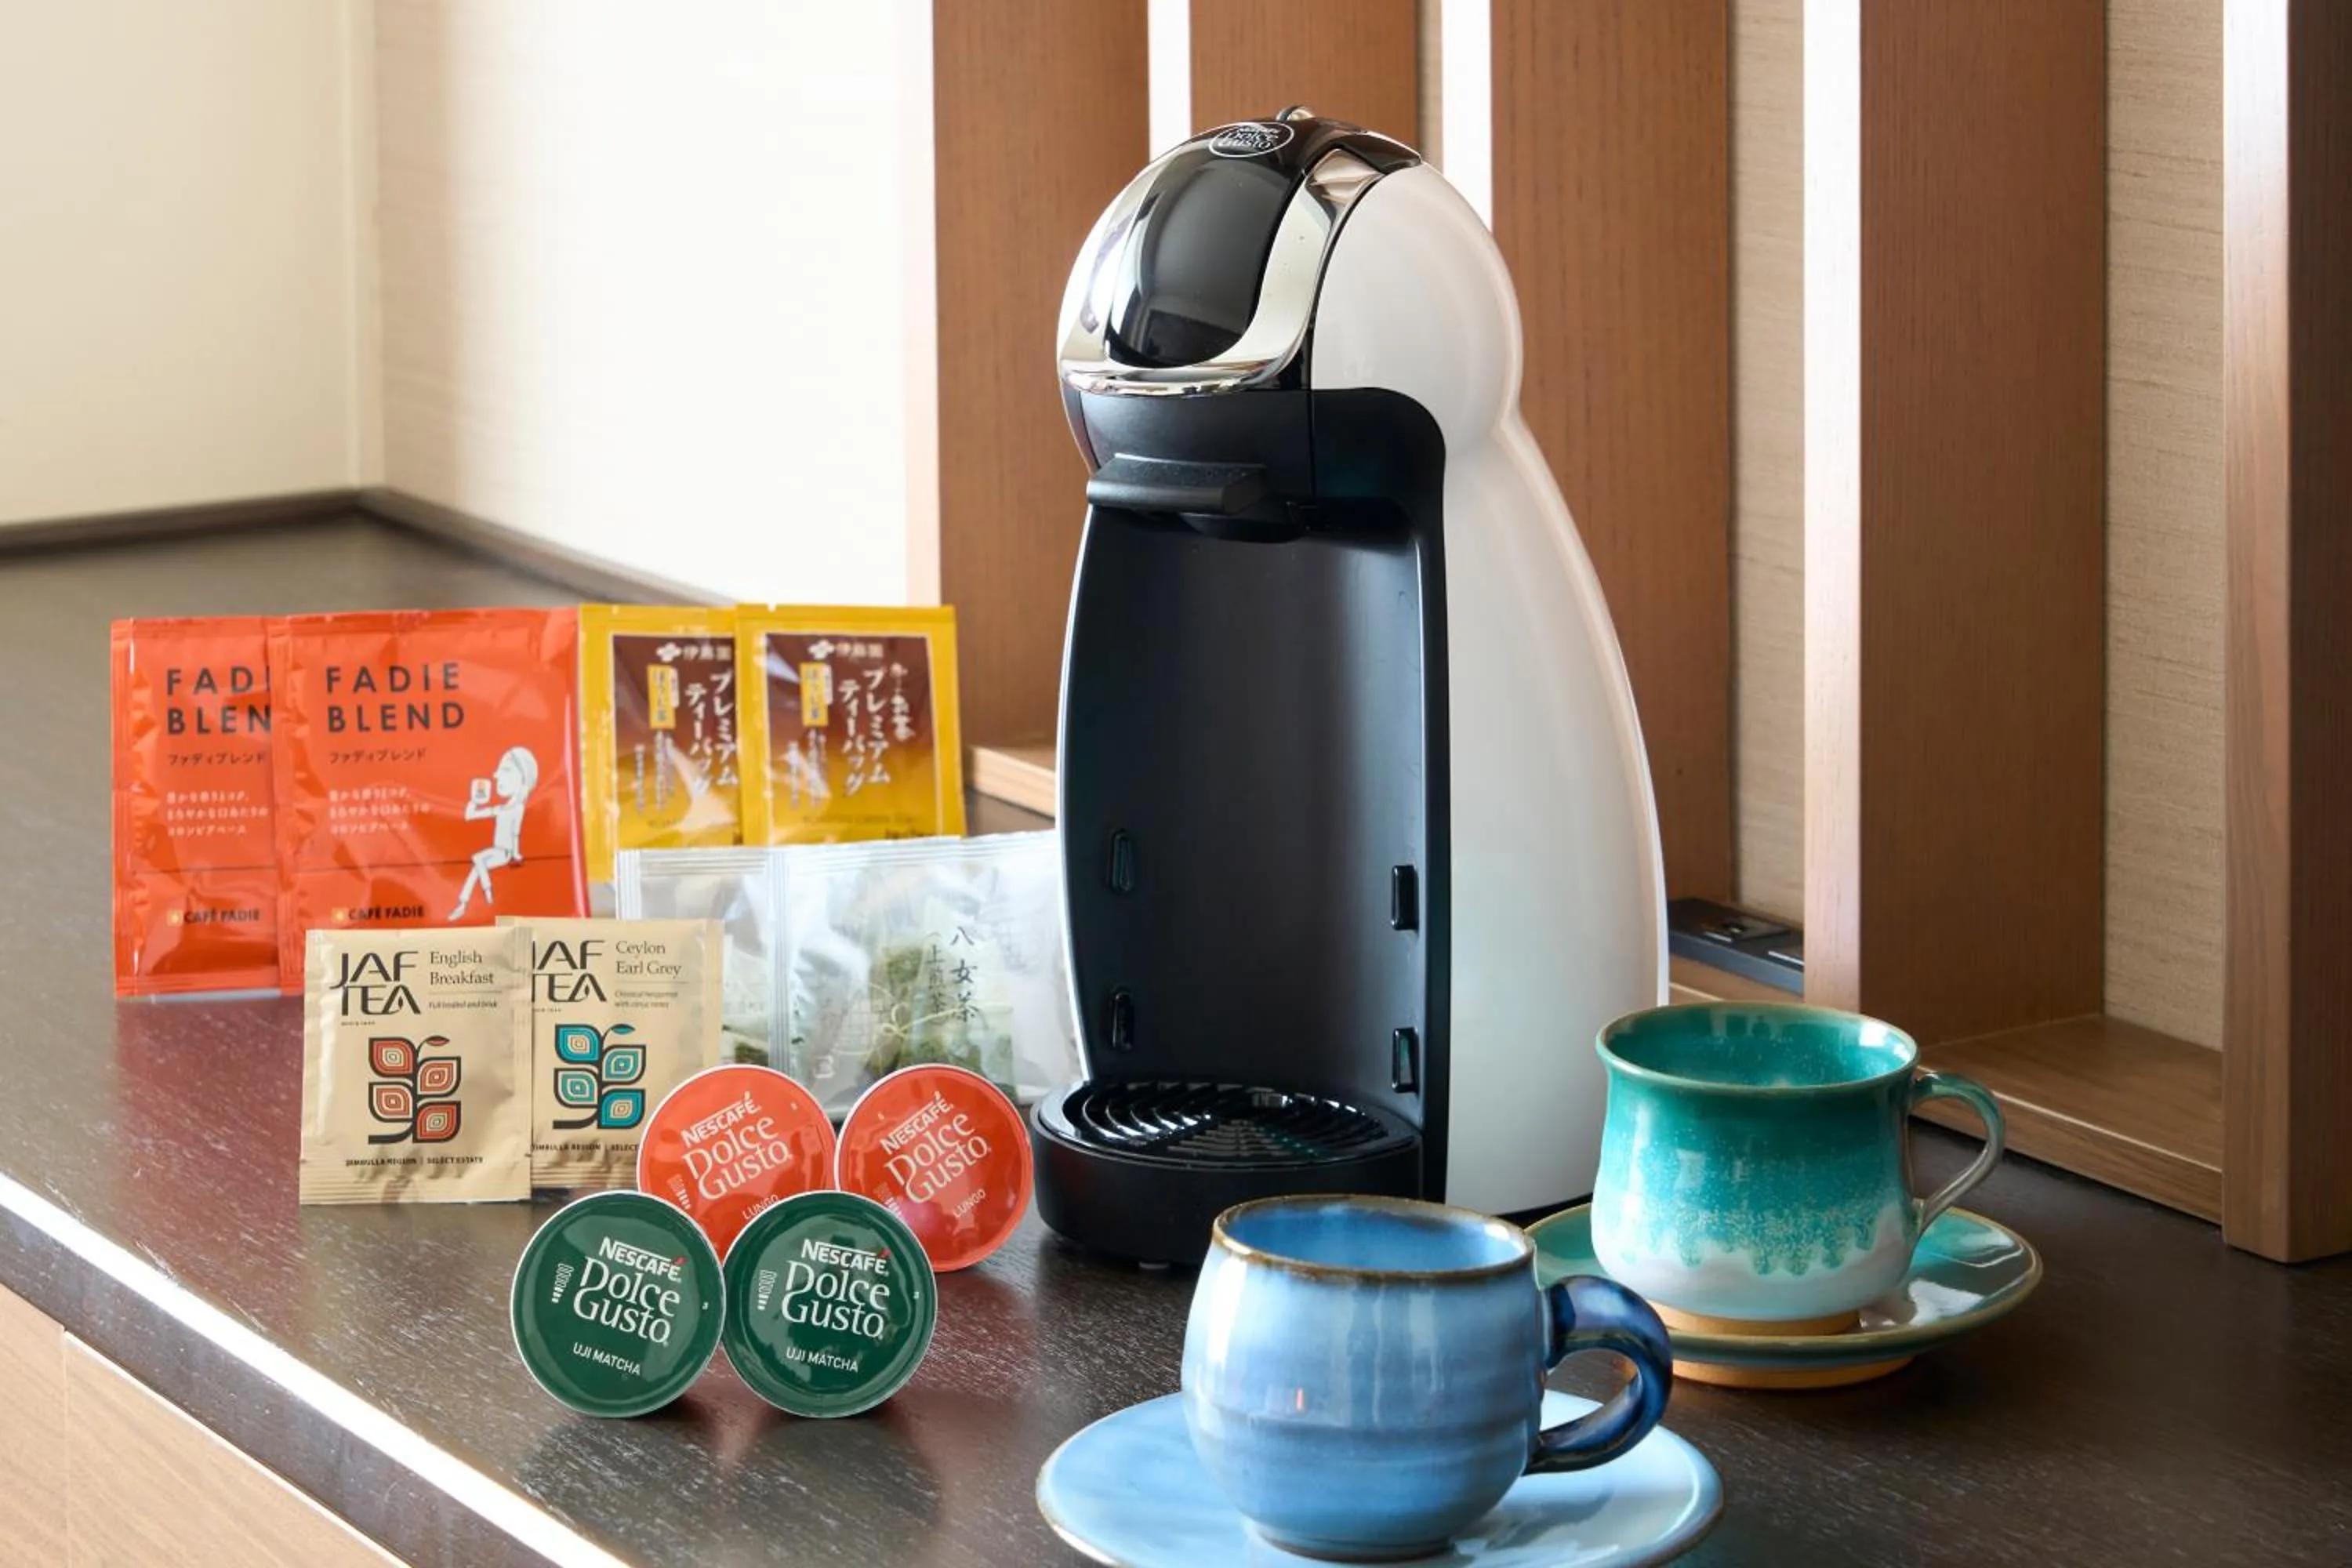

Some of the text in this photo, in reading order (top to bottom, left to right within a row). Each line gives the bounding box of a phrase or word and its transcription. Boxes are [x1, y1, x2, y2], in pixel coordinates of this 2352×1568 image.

[325, 662, 460, 693] FADIE
[167, 704, 270, 735] BLEN
[327, 702, 465, 733] BLEND
[710, 669, 739, 786] プレミアム
[837, 679, 866, 797] ティーバッグ
[862, 666, 891, 784] プレミアム
[329, 951, 419, 989] JAF
[429, 949, 483, 968] English
[615, 940, 666, 954] Ceylon
[616, 960, 681, 979] Earl Grey
[430, 971, 494, 985] Breakfast
[949, 926, 979, 1023] 八女茶
[341, 984, 422, 1016] TEA
[681, 1091, 759, 1149] NESCAFÉ
[880, 1091, 951, 1156] NESCAFÉ
[681, 1116, 779, 1181] Dolce
[698, 1140, 790, 1201] Gusto
[884, 1112, 975, 1186] Dolce
[905, 1135, 989, 1204] Gusto
[953, 1188, 986, 1218] LUNGO
[598, 1236, 687, 1283] NESCAFÉ
[800, 1238, 891, 1275] NESCAFÉ
[585, 1255, 681, 1318] Dolce
[786, 1259, 891, 1311] Dolce
[573, 1287, 671, 1344] Gusto
[781, 1290, 884, 1338] Gusto
[572, 1341, 641, 1376] UJI MATCHA
[786, 1345, 858, 1372] UJI MATCHA
